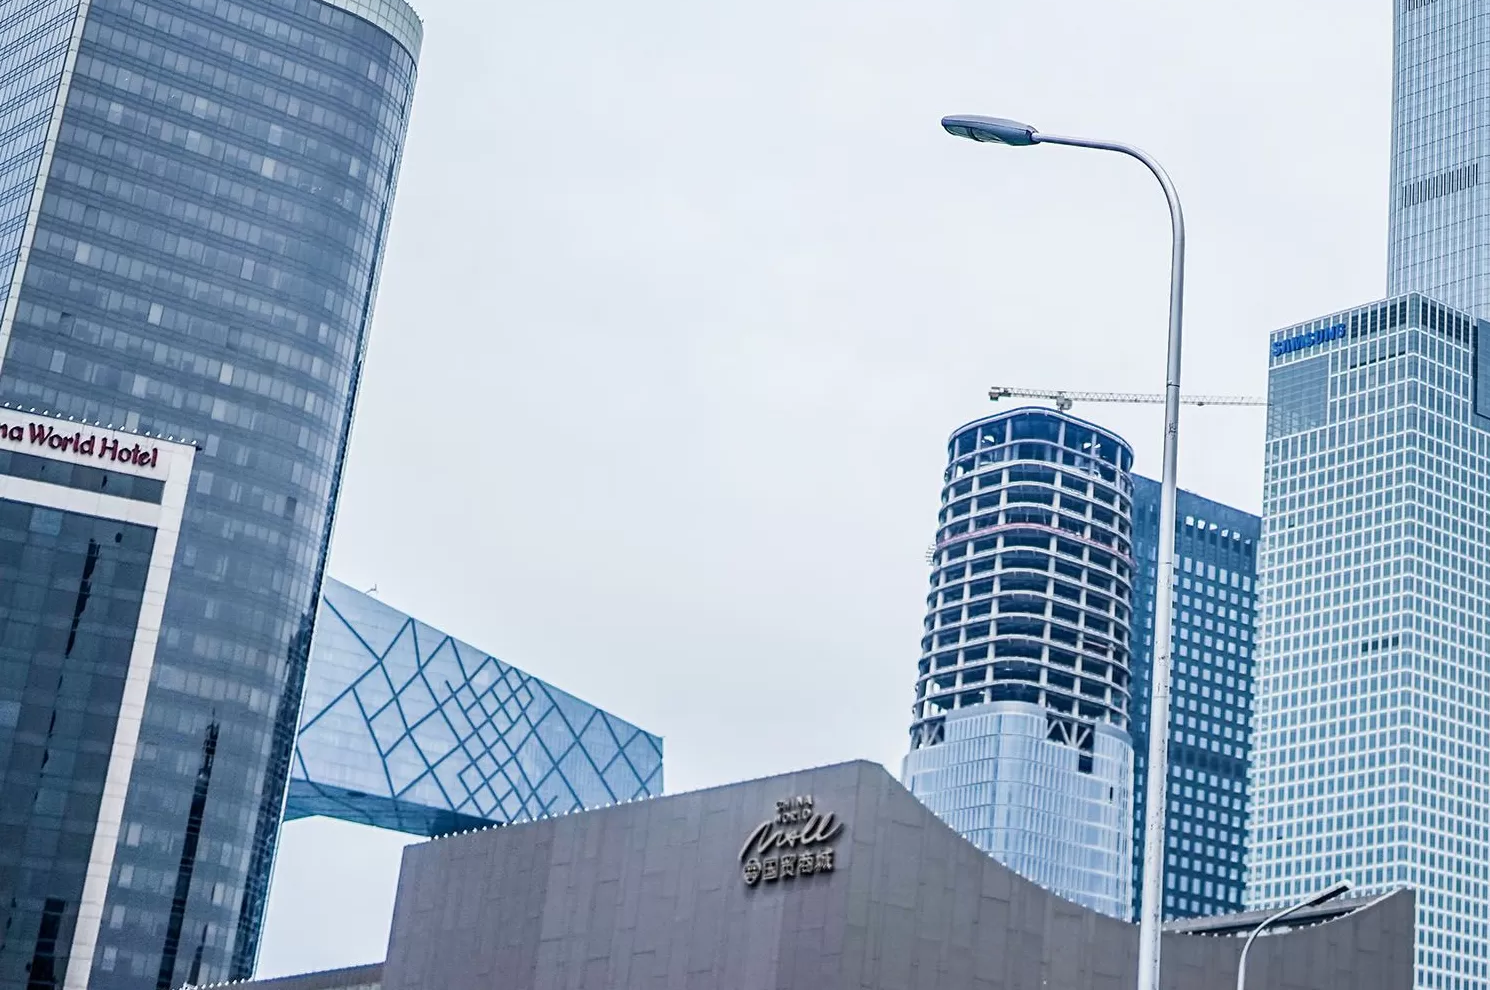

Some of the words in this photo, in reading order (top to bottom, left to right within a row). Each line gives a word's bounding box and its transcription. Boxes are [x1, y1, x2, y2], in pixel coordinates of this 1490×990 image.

[1271, 323, 1346, 357] SAMSUNG
[29, 422, 96, 456] World
[98, 437, 158, 468] Hotel
